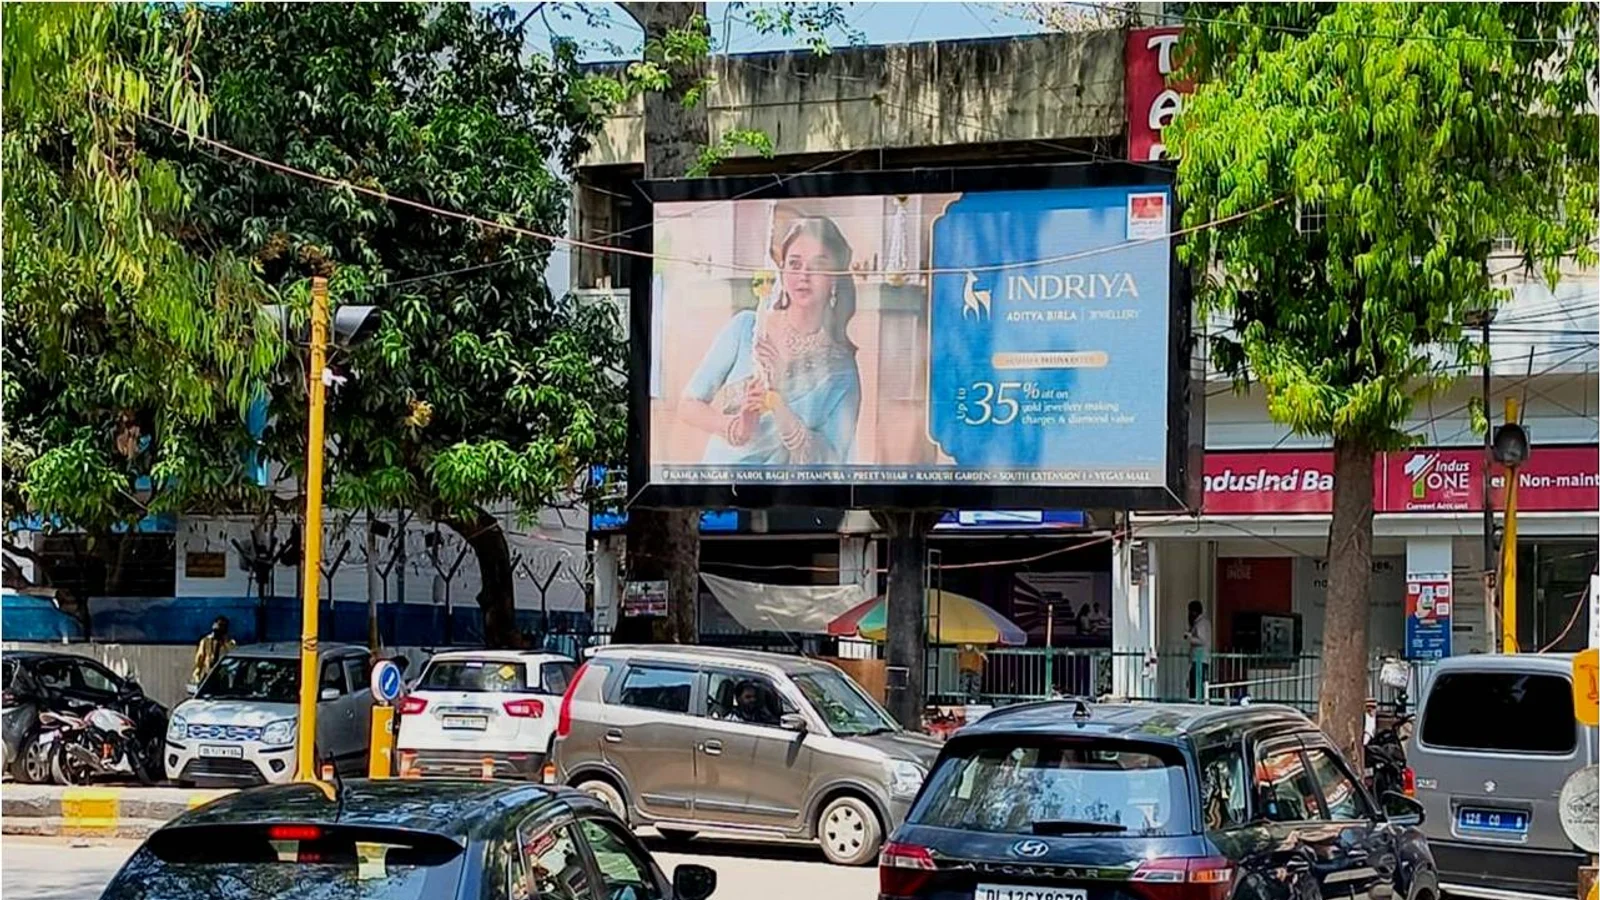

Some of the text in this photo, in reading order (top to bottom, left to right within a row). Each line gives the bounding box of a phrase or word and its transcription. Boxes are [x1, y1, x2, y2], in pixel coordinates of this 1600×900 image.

[1007, 272, 1139, 300] INDRIYA
[1006, 310, 1044, 321] ADITYA
[1046, 310, 1077, 320] BIRLA
[1055, 390, 1069, 400] on
[1021, 400, 1041, 413] gold
[1084, 401, 1119, 413] making
[1021, 414, 1056, 427] charges
[1068, 413, 1109, 424] diamond
[1435, 460, 1470, 472] Indus
[670, 470, 698, 480] KAMLA
[700, 470, 729, 480] NAGAR
[736, 470, 763, 480] KAROL
[797, 471, 845, 480] PITAMPURA
[954, 471, 991, 480] GARDEN
[999, 471, 1029, 480] SOUTH
[1031, 471, 1081, 480] EXTENSION
[1093, 471, 1125, 480] VEGAS
[1125, 471, 1151, 480] MALL
[1203, 469, 1334, 491] ndusInd Ba
[1427, 473, 1469, 489] ONE
[1406, 502, 1468, 510] Current Account
[965, 862, 1099, 878] ALCAZAR
